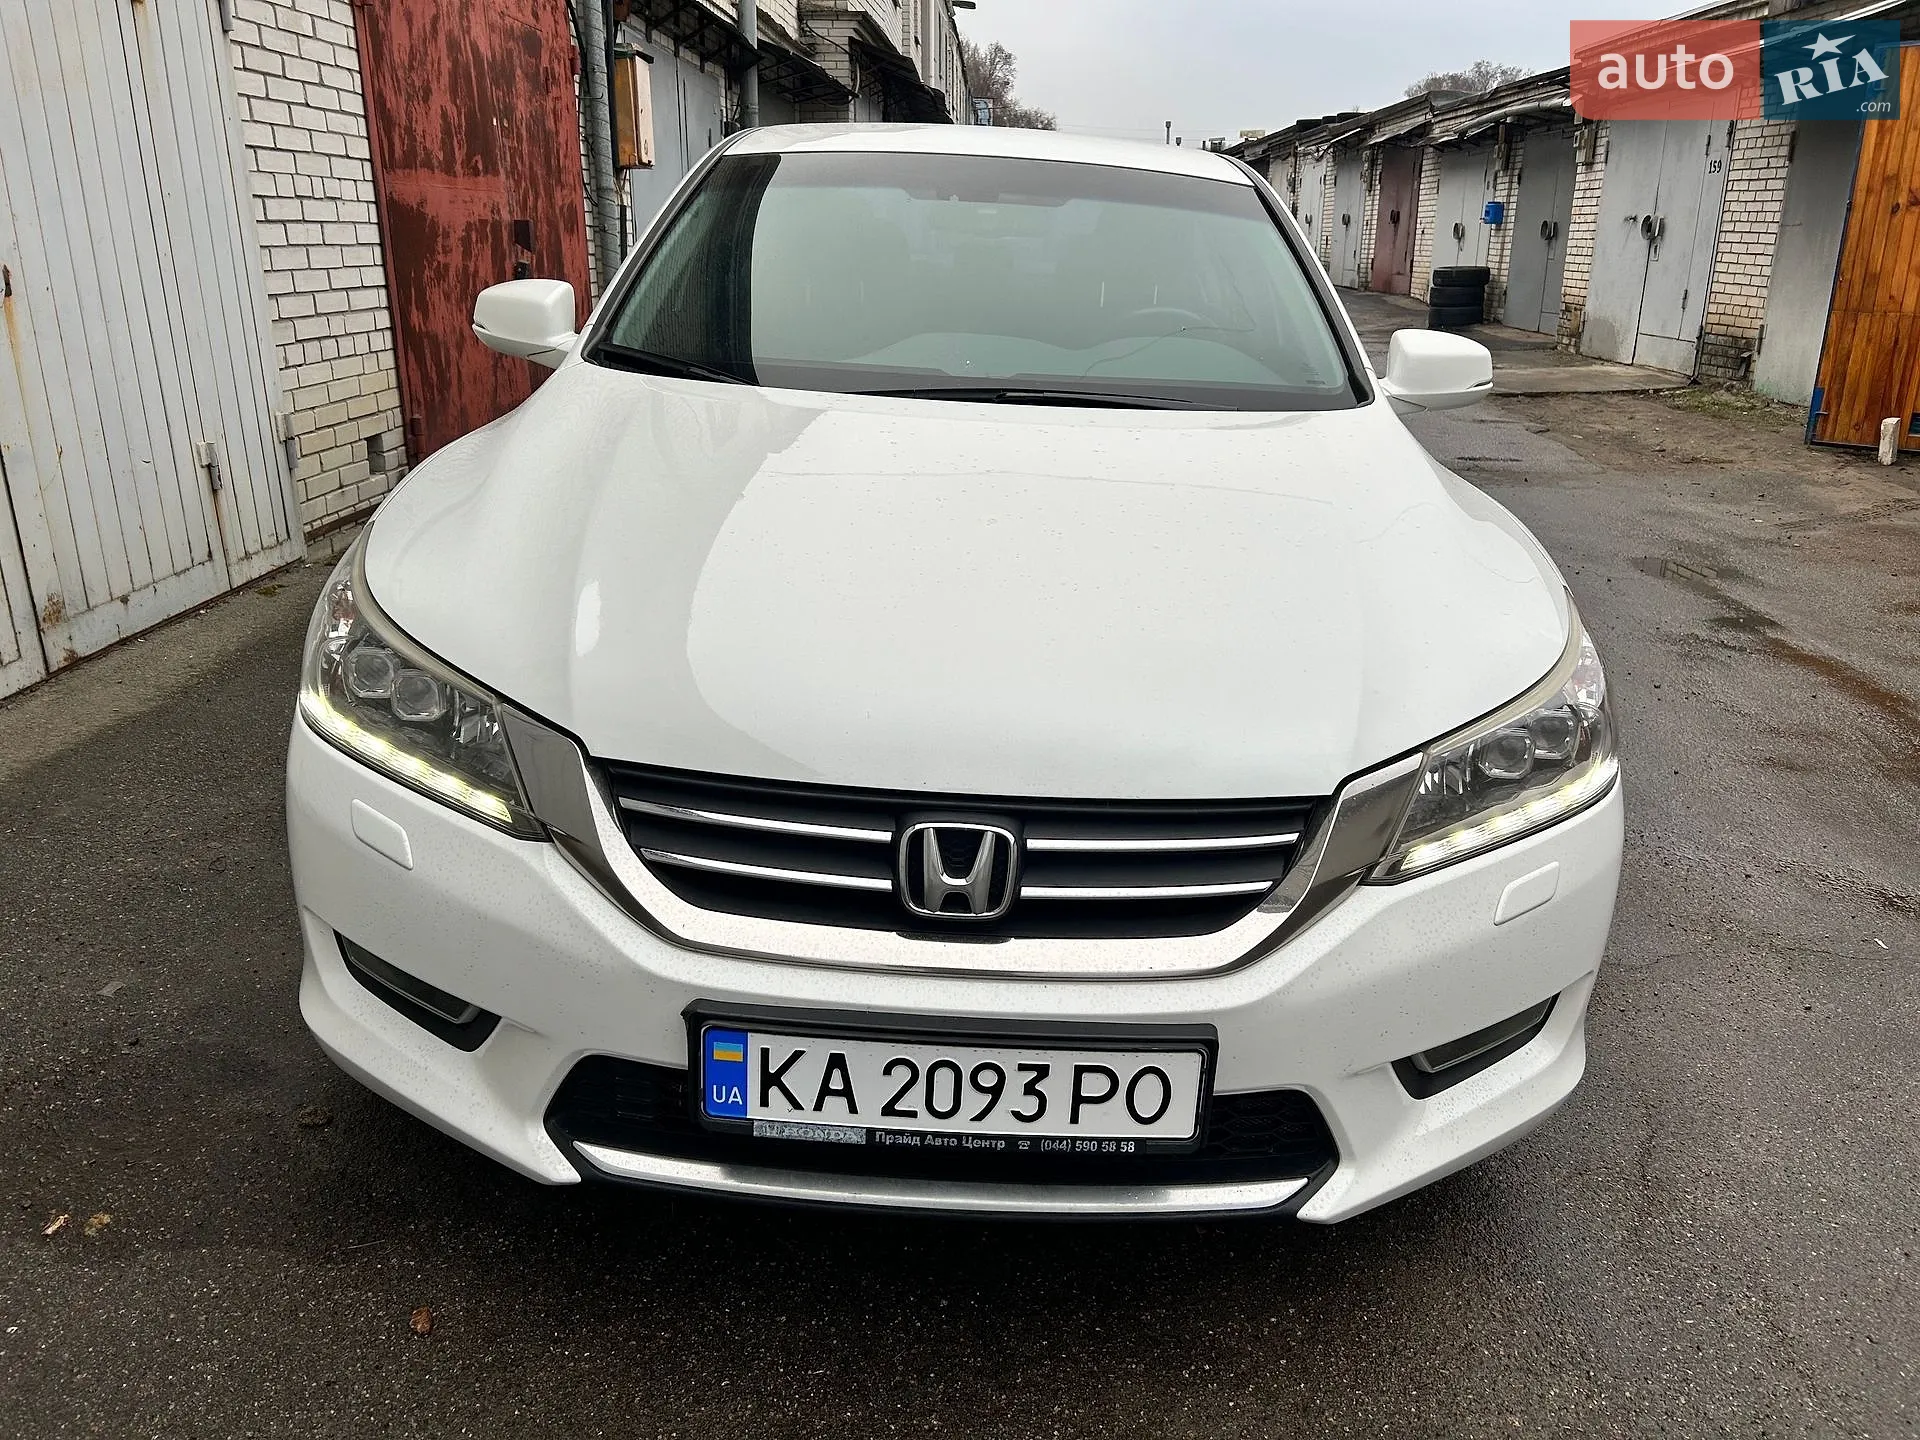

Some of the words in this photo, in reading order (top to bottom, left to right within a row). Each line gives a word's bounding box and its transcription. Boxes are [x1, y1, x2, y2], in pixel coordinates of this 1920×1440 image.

[1708, 159, 1722, 174] 159
[713, 1084, 743, 1106] UA
[760, 1046, 859, 1115] KA
[880, 1057, 1051, 1123] 2093
[1069, 1064, 1172, 1125] PO
[875, 1131, 921, 1147] Прайд
[923, 1134, 958, 1147] Авто
[962, 1136, 1006, 1152] Центр
[1040, 1139, 1072, 1153] (044)
[1075, 1140, 1098, 1152] 590
[1119, 1141, 1136, 1153] 58
